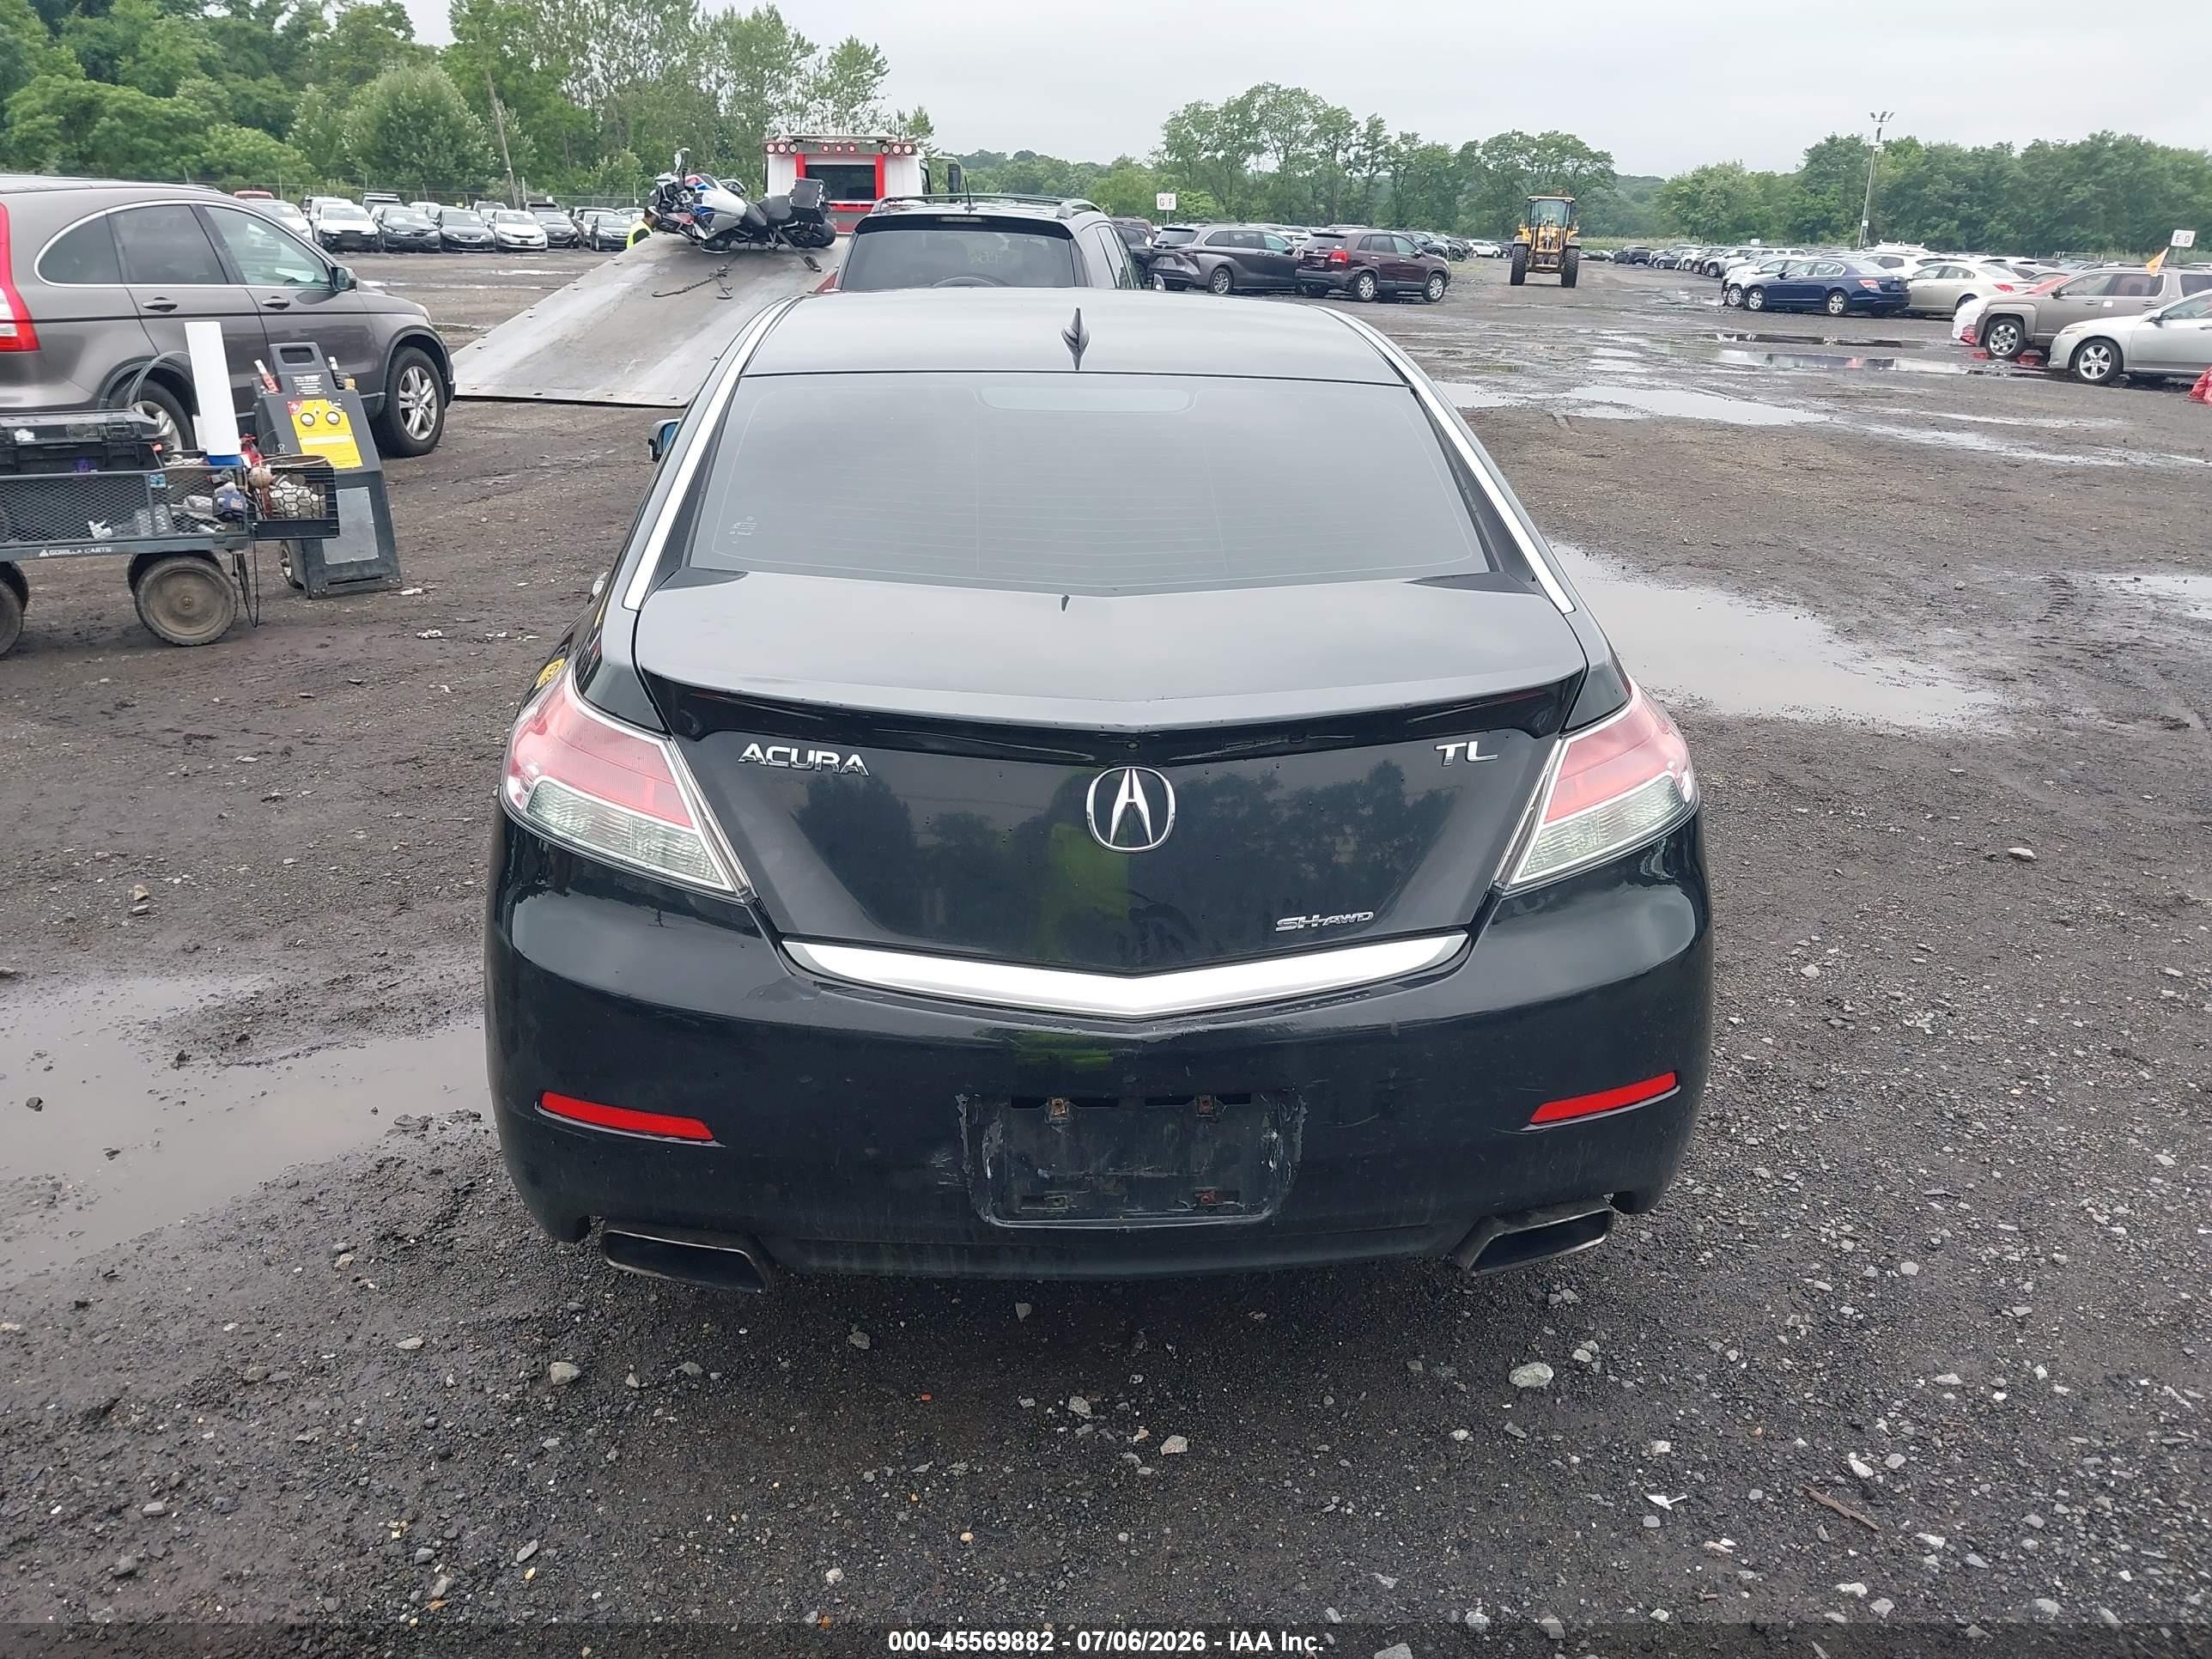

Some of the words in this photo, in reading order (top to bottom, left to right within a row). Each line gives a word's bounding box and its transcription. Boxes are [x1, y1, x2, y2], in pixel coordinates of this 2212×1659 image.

[738, 743, 870, 777] ACURA
[1435, 740, 1498, 767] TL
[1274, 911, 1374, 933] SH-AWD
